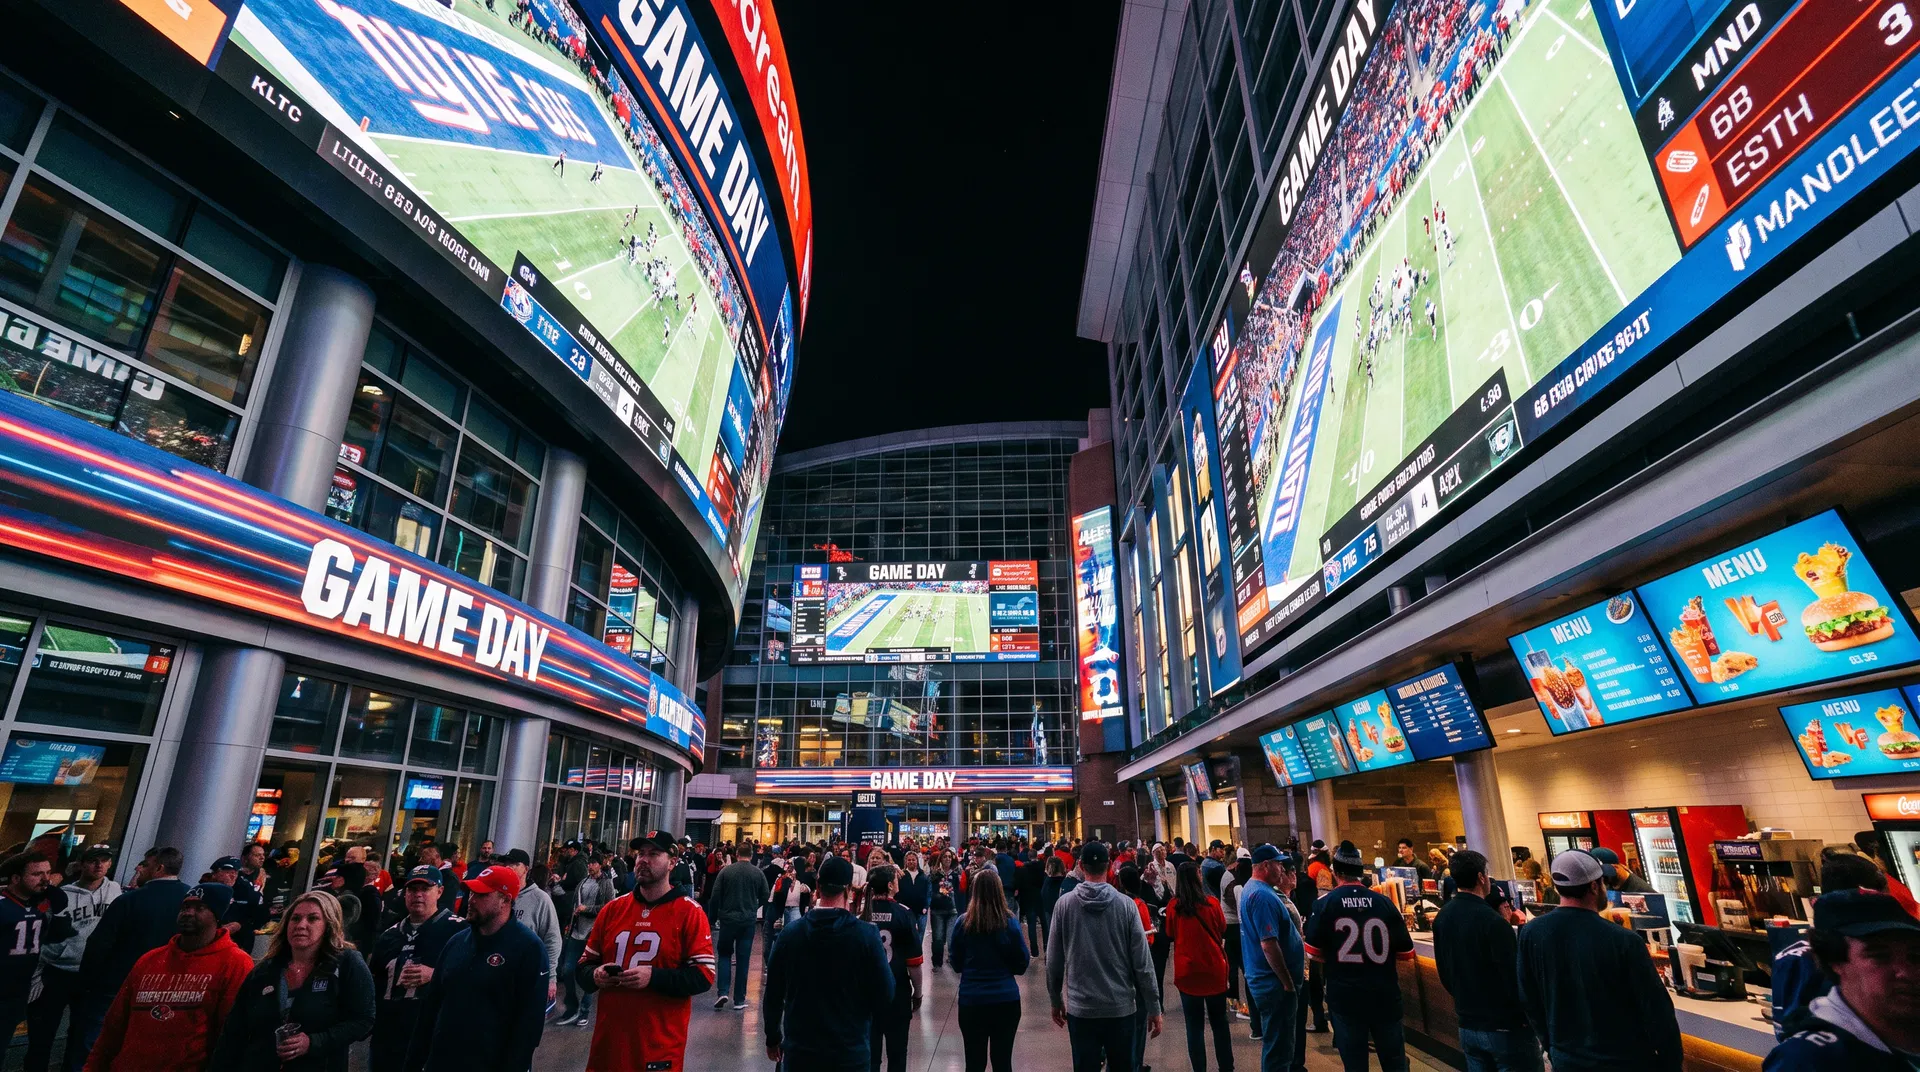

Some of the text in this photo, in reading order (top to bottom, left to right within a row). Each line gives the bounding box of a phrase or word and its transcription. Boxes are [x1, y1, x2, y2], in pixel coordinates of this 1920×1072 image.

[1690, 2, 1762, 91] MND
[1878, 2, 1913, 46] 3
[251, 75, 302, 123] KLTC
[1278, 0, 1377, 226] GAME DAY
[1710, 85, 1753, 140] 6B
[1726, 92, 1814, 188] ESTH
[719, 140, 770, 268] DAY
[869, 563, 947, 580] GAME DAY
[1702, 547, 1768, 590] MENU
[301, 538, 550, 682] GAME DAY
[1550, 615, 1593, 645] MENU
[1821, 699, 1861, 717] MENU
[870, 771, 956, 790] GAME DAY
[10, 919, 43, 955] 11
[615, 930, 661, 970] 12
[1334, 917, 1390, 965] 20
